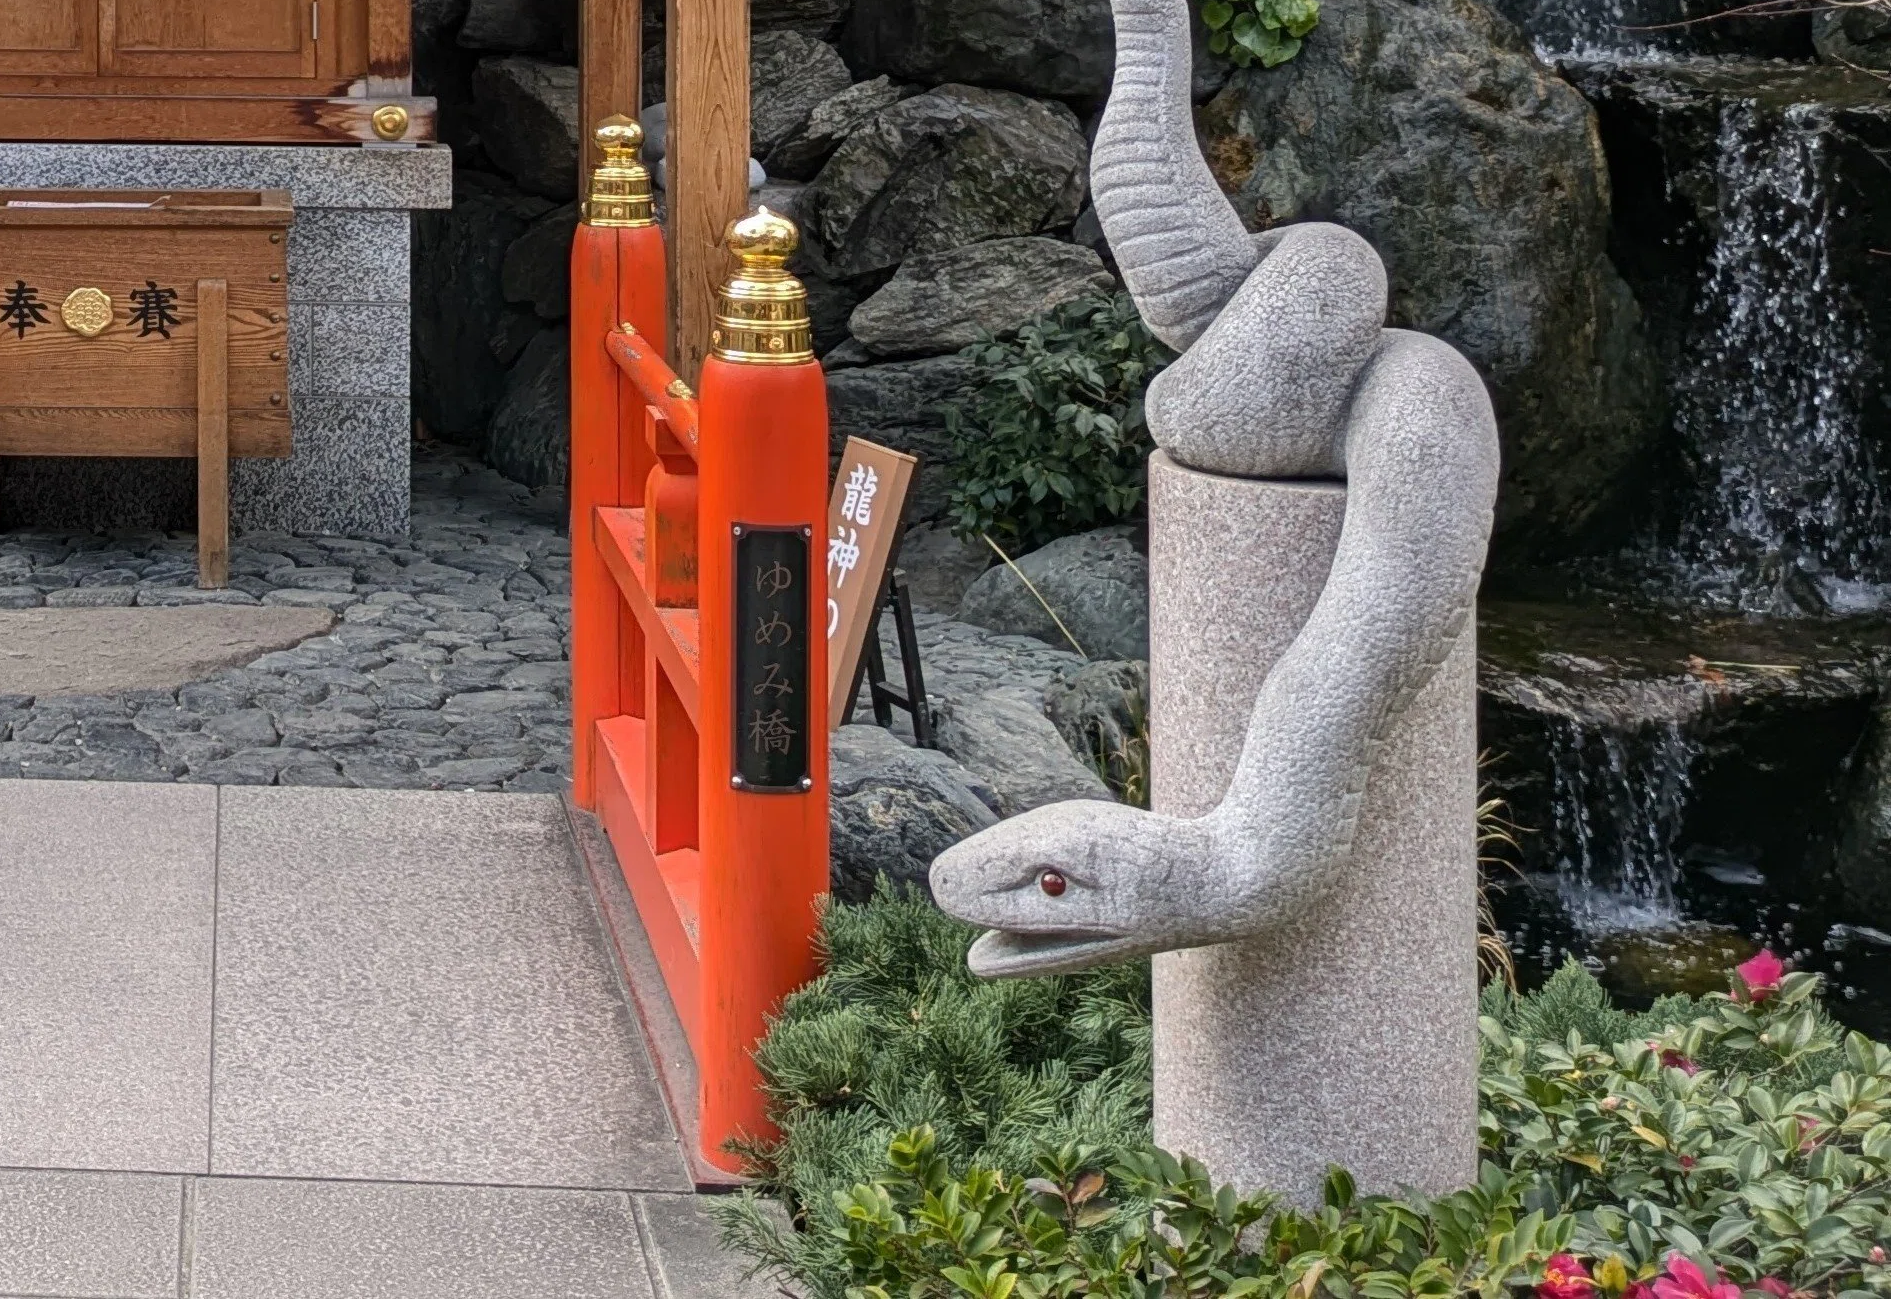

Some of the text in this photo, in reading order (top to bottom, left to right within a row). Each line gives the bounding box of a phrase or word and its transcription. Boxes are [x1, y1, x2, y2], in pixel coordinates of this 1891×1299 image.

[126, 280, 181, 339] 賽
[748, 561, 796, 755] ゆめみ橋
